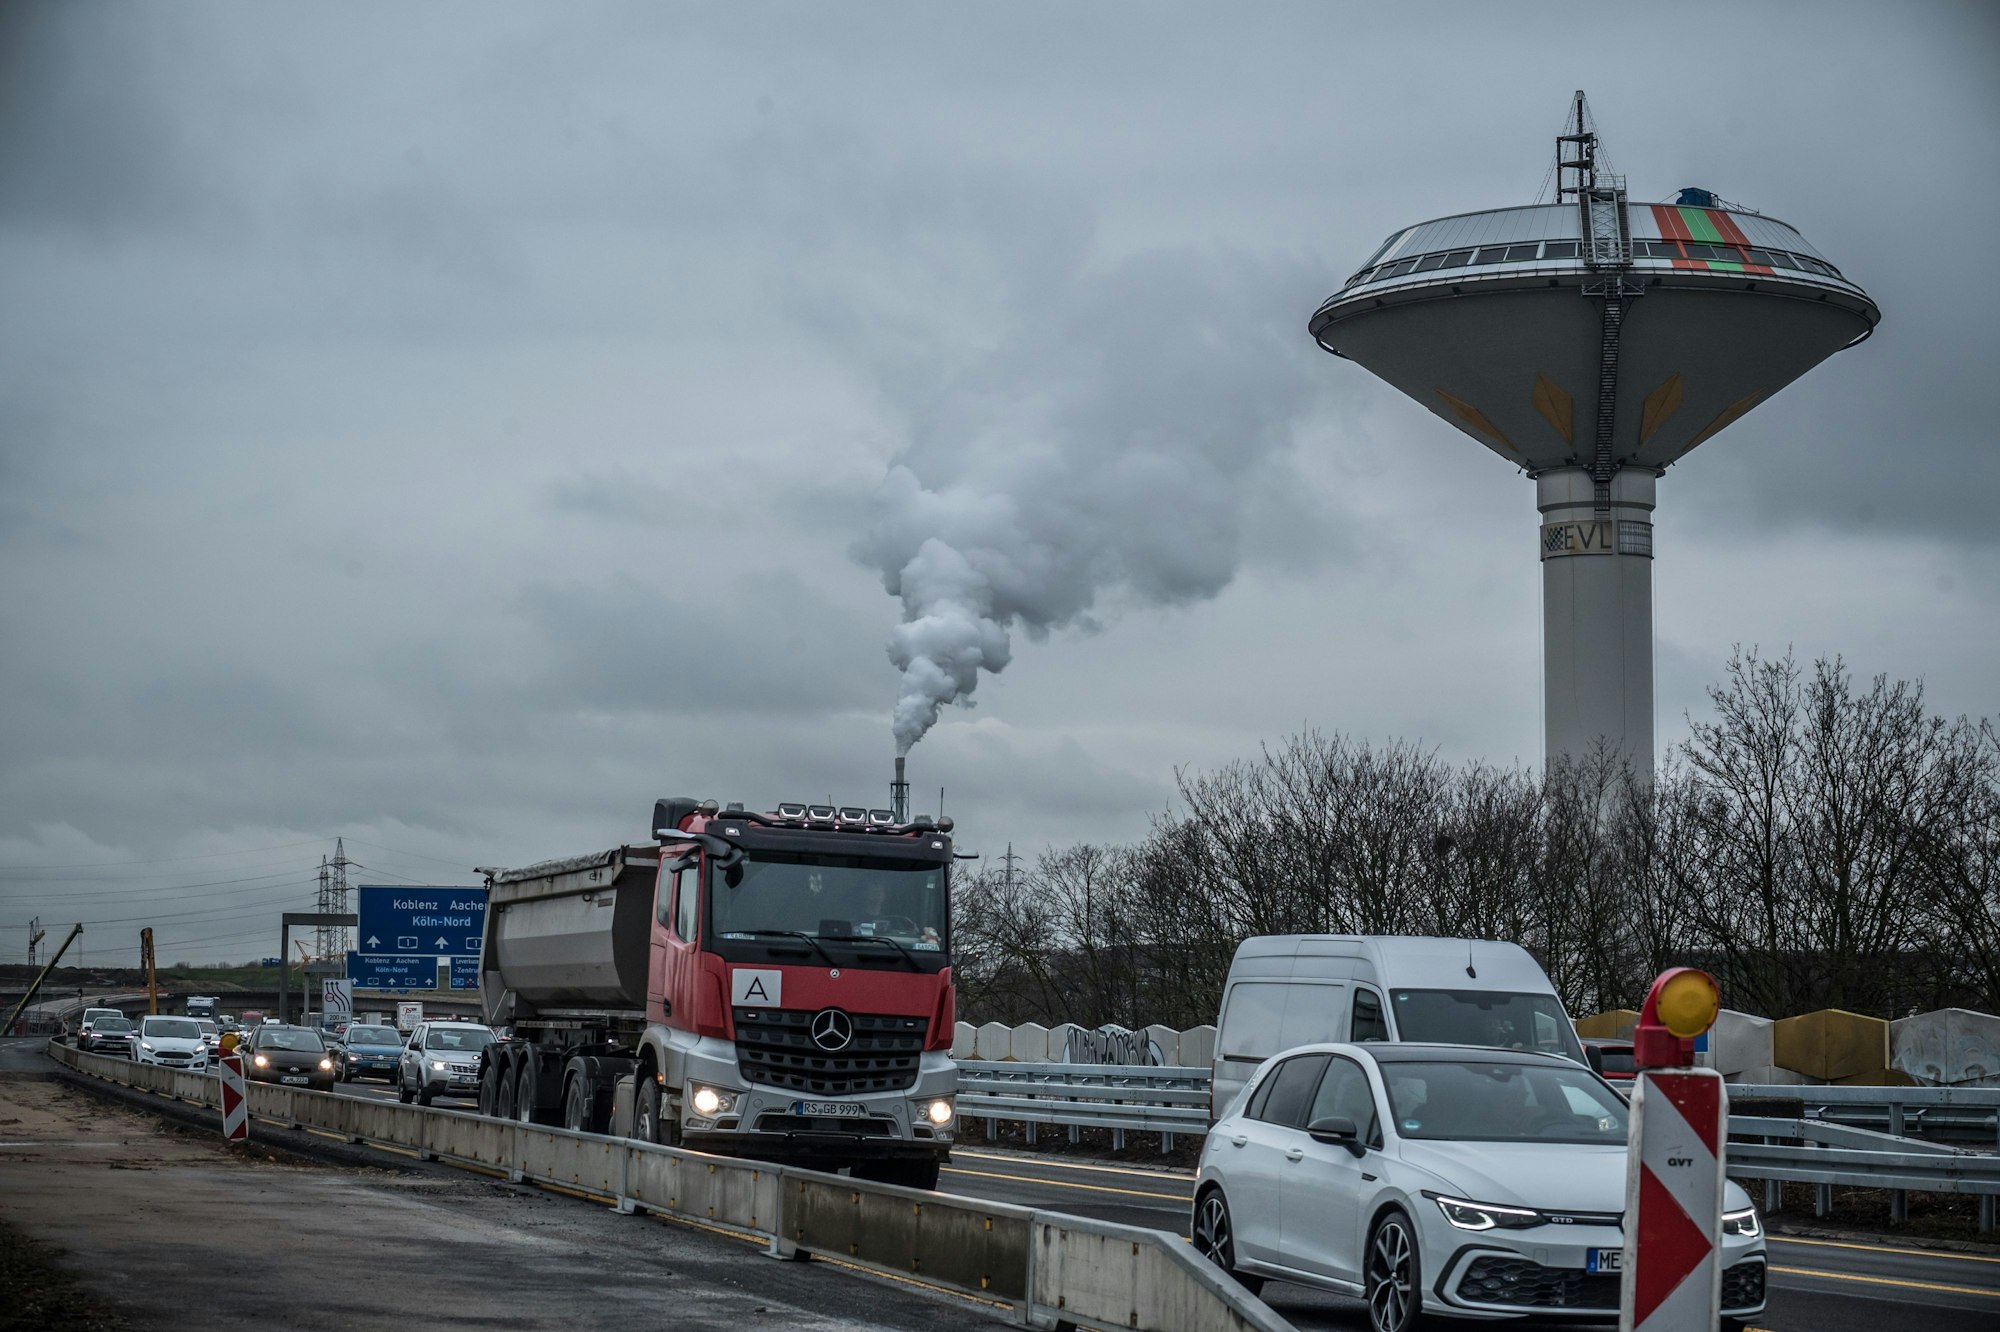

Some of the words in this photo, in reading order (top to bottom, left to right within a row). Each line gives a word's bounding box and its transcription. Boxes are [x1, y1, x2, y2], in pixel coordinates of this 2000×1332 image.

[1564, 524, 1612, 549] EVL
[393, 899, 438, 910] Koblenz
[412, 916, 471, 926] Köln-Nord
[744, 976, 769, 1001] A
[804, 1103, 818, 1113] RS
[824, 1104, 837, 1114] GB
[840, 1105, 858, 1115] 999
[1667, 1158, 1694, 1167] GVT
[1551, 1216, 1573, 1224] GTD
[1600, 1252, 1621, 1269] ME
